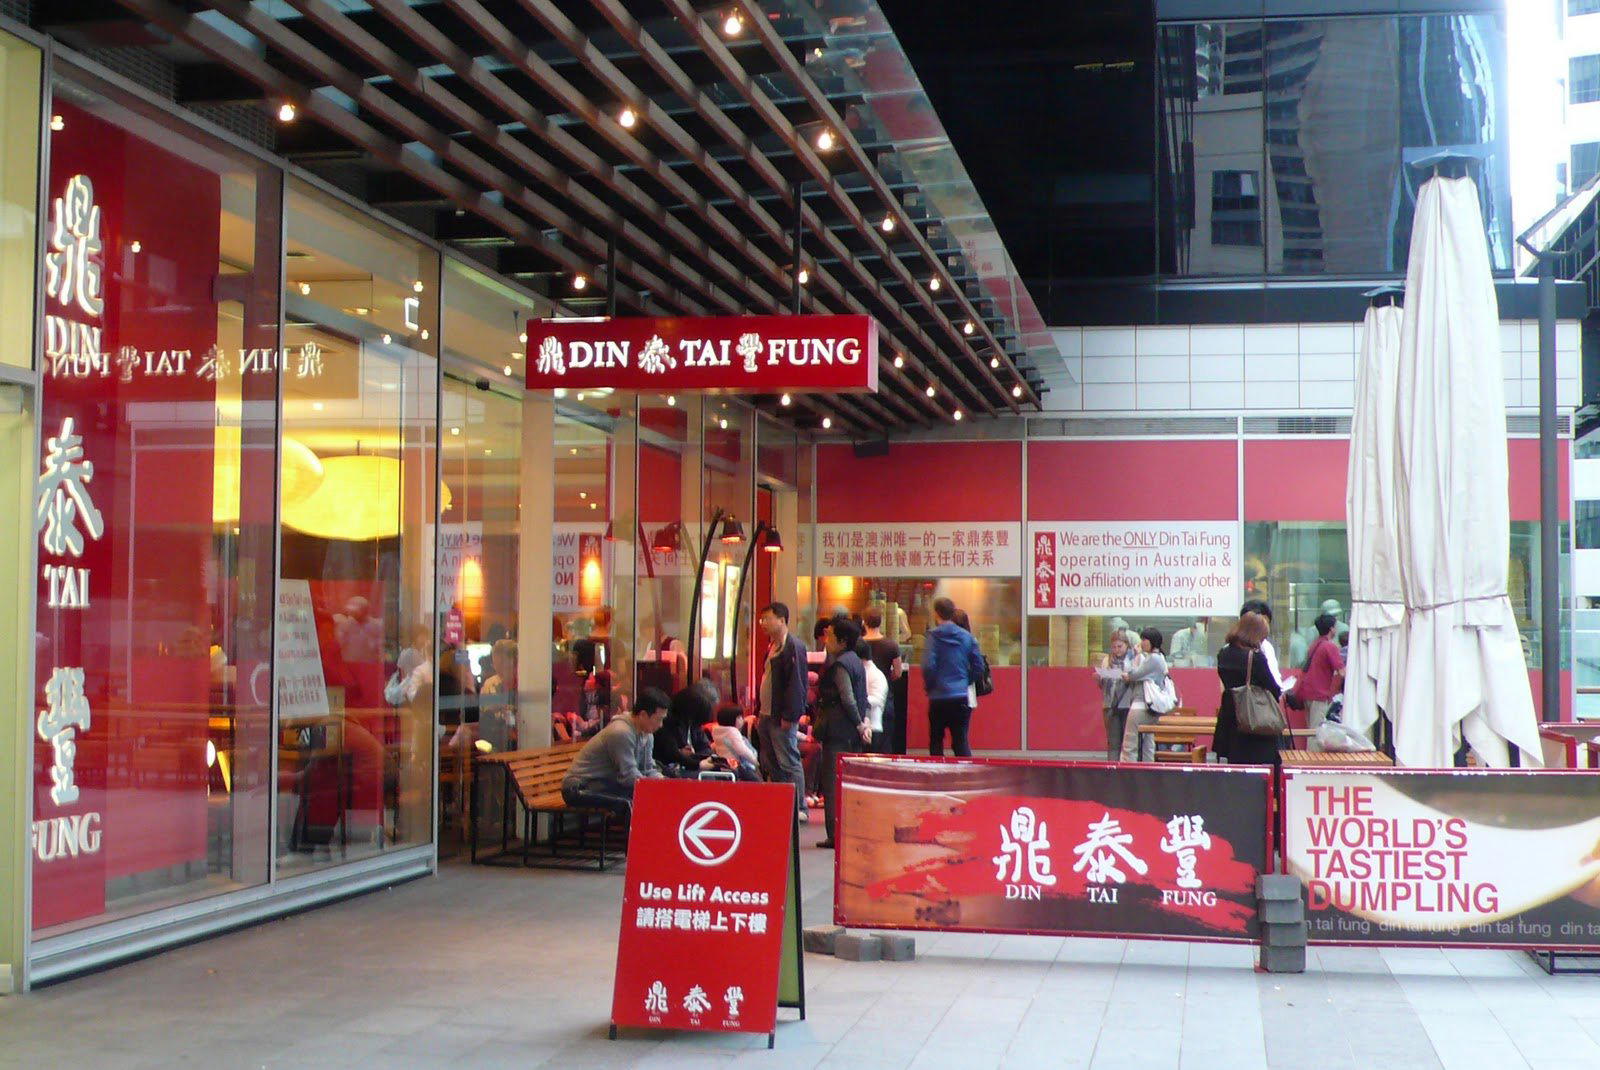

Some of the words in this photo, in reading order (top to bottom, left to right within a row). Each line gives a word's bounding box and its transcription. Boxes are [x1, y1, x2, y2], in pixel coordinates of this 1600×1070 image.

[46, 174, 104, 318] 鼎
[46, 315, 102, 370] DIN
[536, 336, 566, 375] 鼎
[569, 341, 630, 369] DIN
[638, 335, 676, 374] 泰
[680, 340, 731, 367] TAI
[767, 338, 861, 366] FUNG
[38, 417, 104, 556] 泰
[1060, 531, 1079, 546] We
[1081, 534, 1100, 546] are
[1102, 532, 1122, 546] the
[1123, 531, 1156, 547] ONLY
[1159, 531, 1180, 546] Din
[1181, 531, 1198, 546] Tai
[1200, 532, 1230, 550] Fung
[1060, 553, 1130, 570] operating
[1135, 553, 1148, 566] in
[1153, 553, 1216, 567] Australia
[1221, 553, 1231, 567] &
[44, 565, 90, 608] TAI
[1060, 574, 1081, 587] NO
[1083, 572, 1141, 587] affiliation
[1144, 573, 1171, 588] with
[1173, 576, 1196, 591] any
[1199, 574, 1231, 588] other
[1060, 594, 1134, 609] restaurants
[1138, 594, 1151, 608] in
[1154, 593, 1213, 609] Australia
[1306, 786, 1374, 816] THE
[993, 806, 1212, 888] 鼎泰豐
[1306, 849, 1468, 881] TASTIEST
[639, 882, 672, 899] Use
[677, 884, 706, 902] Lift
[709, 886, 769, 904] Access
[1005, 883, 1042, 901] DIN
[1087, 887, 1118, 904] TAI
[1162, 890, 1217, 907] FUNG
[1308, 880, 1499, 913] DUMPLING
[1317, 917, 1334, 931] tai
[1338, 917, 1371, 934] fung
[1468, 919, 1493, 934] din
[1496, 920, 1514, 935] tai
[1519, 920, 1552, 938] fung
[1560, 921, 1585, 936] din
